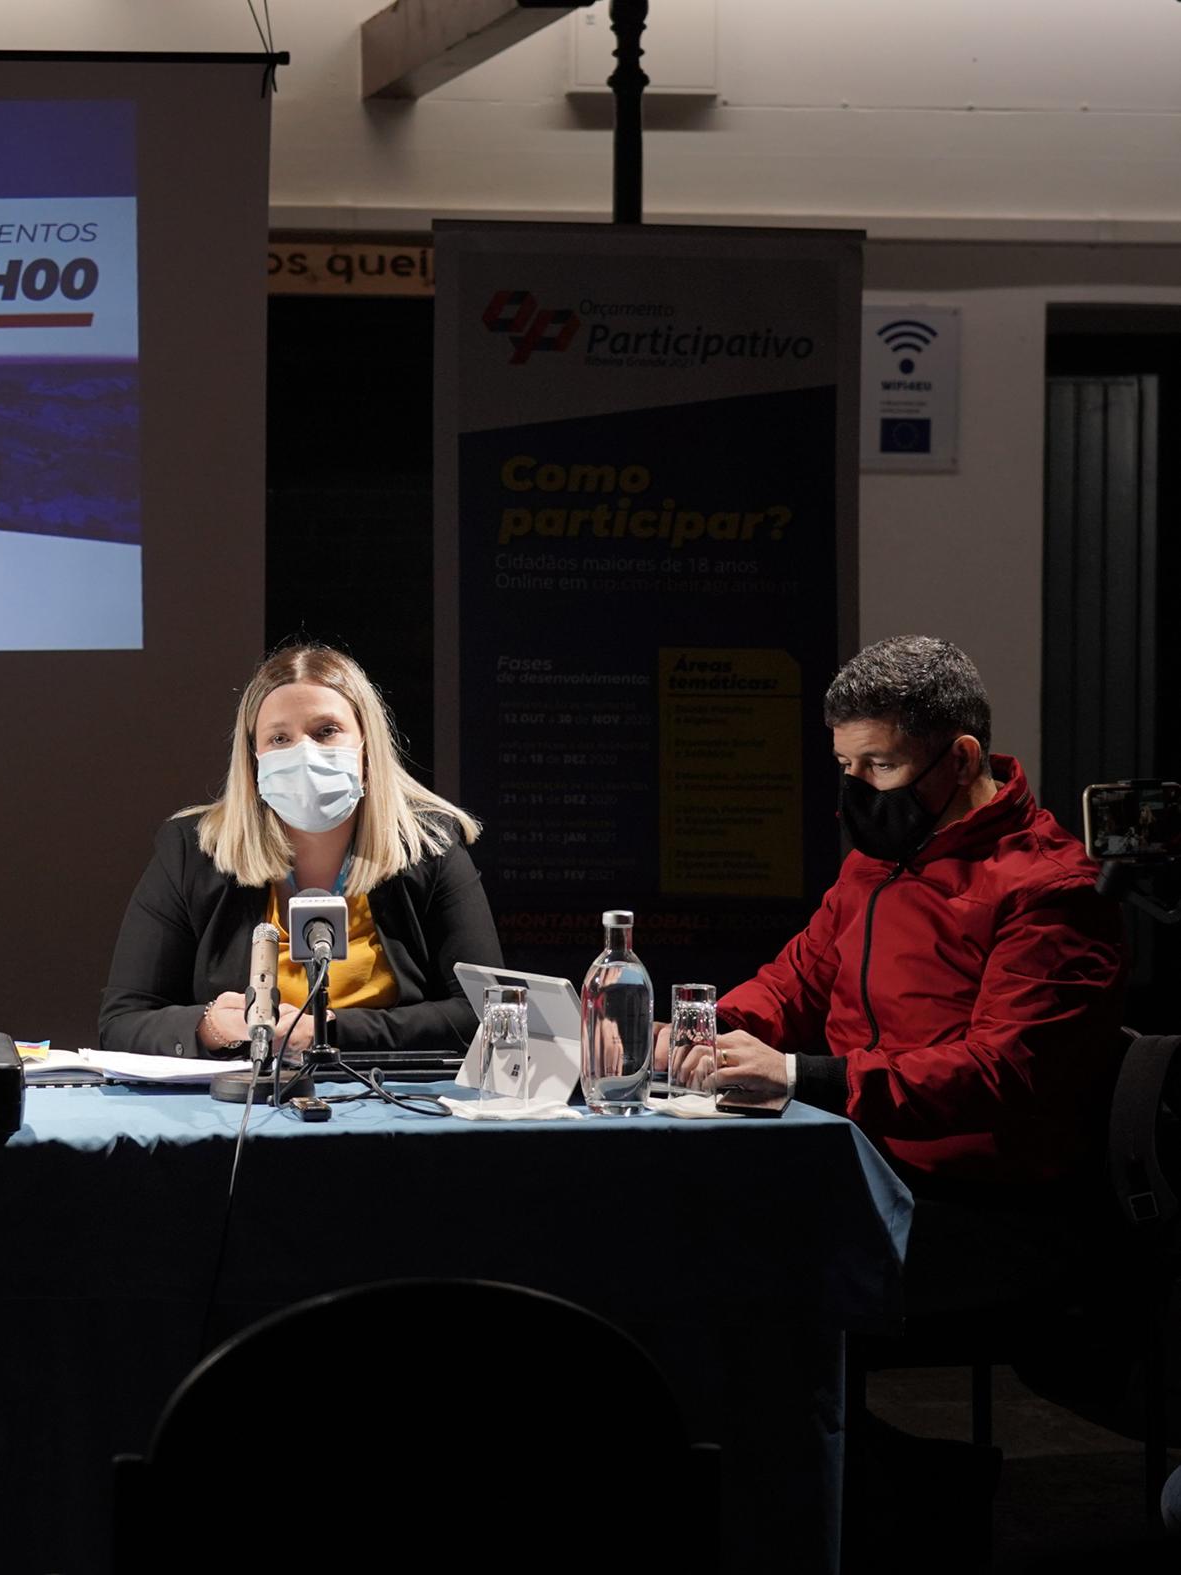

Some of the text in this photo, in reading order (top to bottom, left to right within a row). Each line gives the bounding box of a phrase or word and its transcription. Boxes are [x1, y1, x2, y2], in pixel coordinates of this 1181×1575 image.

[327, 250, 436, 283] quei
[579, 299, 675, 318] Orçamento
[586, 324, 815, 364] Participativo
[499, 454, 655, 496] Como
[497, 495, 797, 550] participar?
[494, 552, 760, 575] Cidadãos maiores de 18 anos
[494, 573, 555, 591] Online
[557, 578, 589, 591] em
[496, 655, 554, 672] Fases
[673, 653, 733, 673] Áreas
[495, 670, 651, 686] de desenvolvimento:
[667, 673, 780, 691] temáticas:
